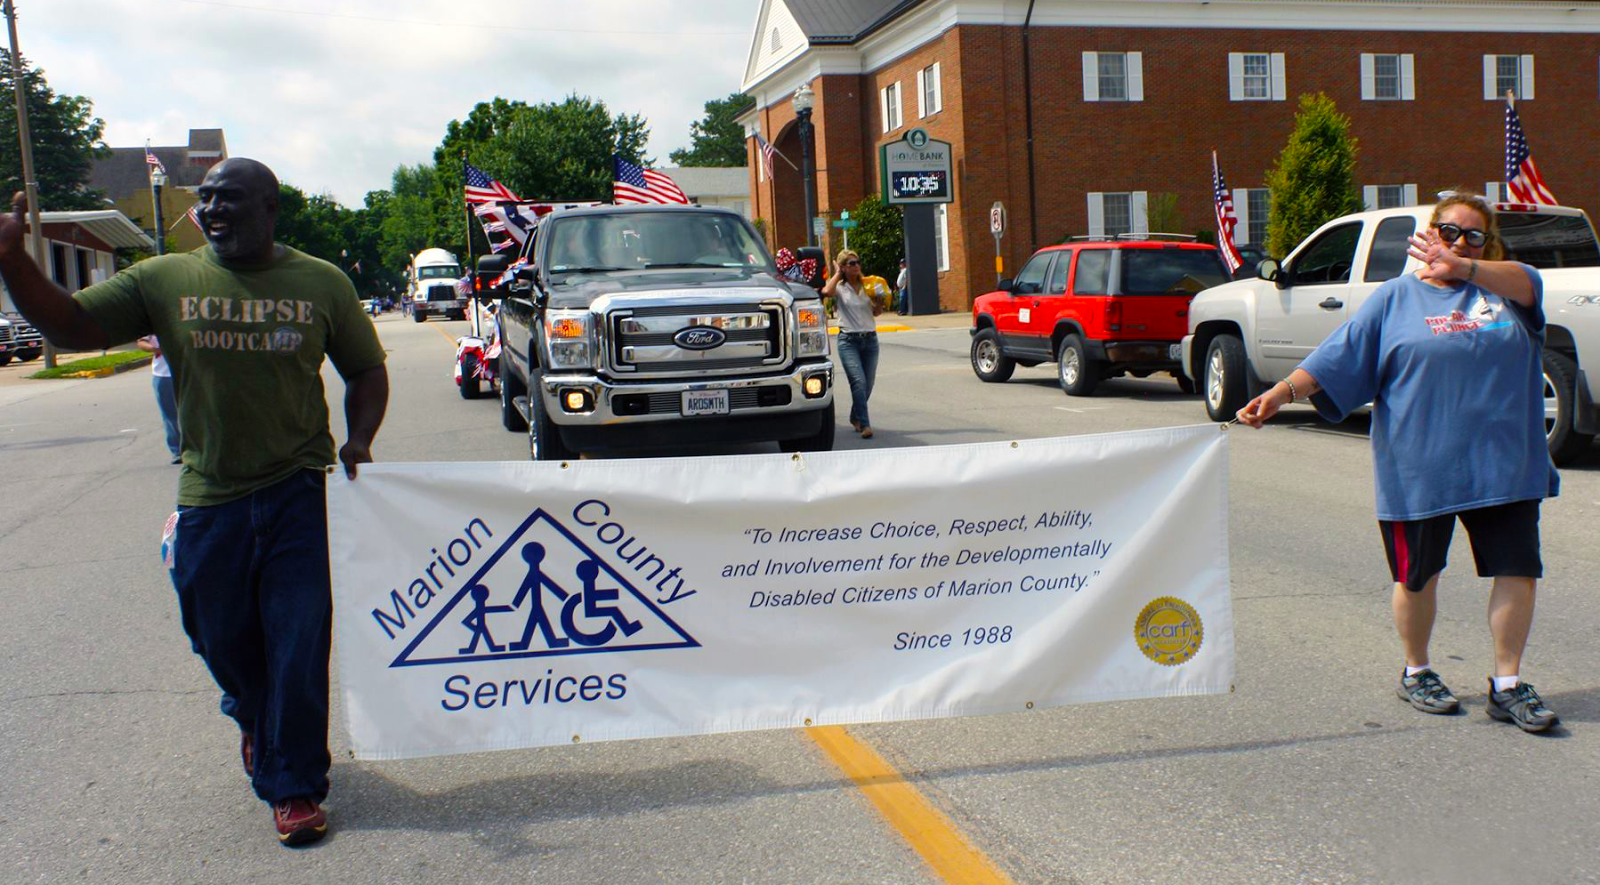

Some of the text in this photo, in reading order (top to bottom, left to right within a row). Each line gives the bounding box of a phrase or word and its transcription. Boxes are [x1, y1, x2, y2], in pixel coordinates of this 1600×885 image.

[179, 296, 314, 325] ECLIPSE
[686, 331, 714, 344] Ford
[778, 526, 863, 543] Increase
[869, 520, 940, 539] Choice,
[948, 514, 1029, 537] Respect,
[1034, 509, 1093, 530] Ability,
[573, 499, 698, 605] County
[721, 538, 1113, 578] and Involvement for the Developmentally
[371, 517, 494, 641] Marion
[748, 587, 838, 609] Disabled
[842, 585, 919, 605] Citizens
[923, 580, 946, 600] of
[947, 577, 1013, 598] Marion
[892, 624, 1014, 651] Since 1988
[1148, 620, 1191, 639] carf
[440, 668, 628, 712] Services
